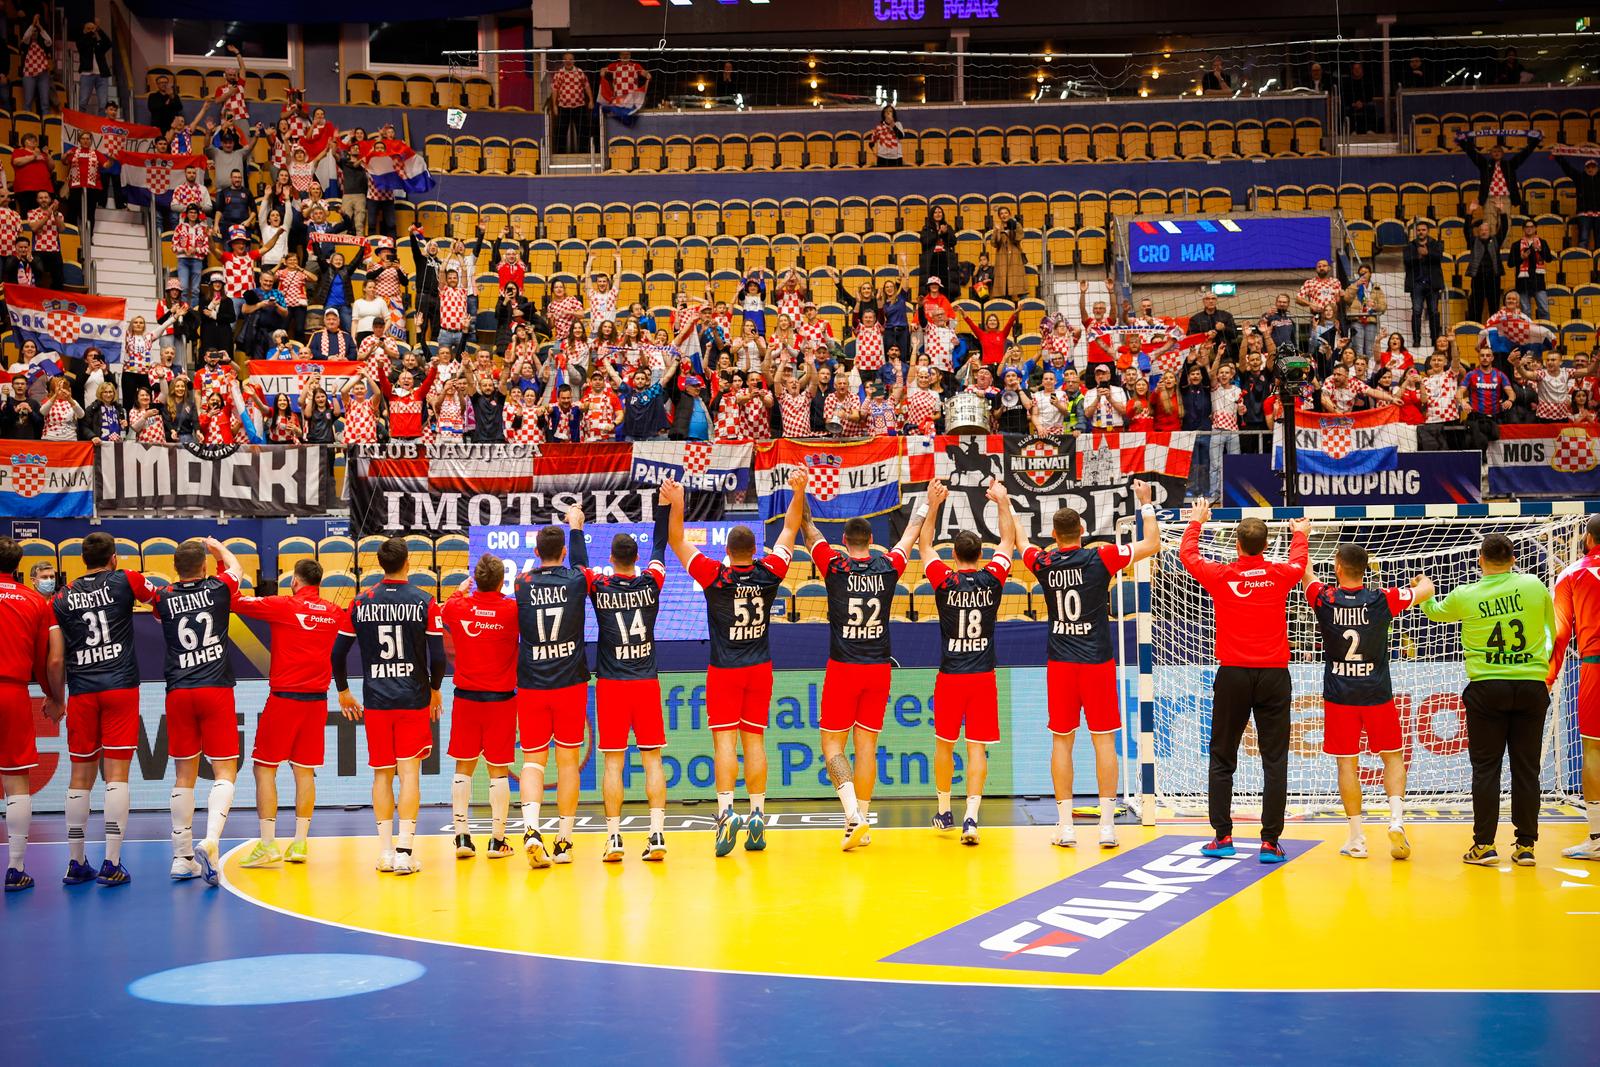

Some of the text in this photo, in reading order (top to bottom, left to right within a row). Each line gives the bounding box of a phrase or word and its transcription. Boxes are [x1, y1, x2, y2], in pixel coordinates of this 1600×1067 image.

[874, 0, 1000, 20] CRO MAR
[1139, 243, 1215, 262] CRO MAR
[81, 322, 122, 337] OVO
[260, 376, 293, 393] VIT
[1355, 429, 1375, 449] IN
[358, 443, 418, 459] KLUB
[1011, 454, 1070, 470] MI HRVATI
[1503, 443, 1545, 462] MOS
[49, 473, 88, 488] ANJA
[101, 440, 320, 506] IMOCKI
[848, 464, 887, 489] VLJE
[1293, 470, 1421, 496] ONKOPING
[383, 488, 657, 530] IMOTSKI
[487, 531, 519, 549] CRO
[847, 571, 885, 596] ŠUŠNJA
[1048, 568, 1083, 590] GOJUN
[67, 581, 114, 611] ŠEBETIĆ
[167, 585, 214, 619] JELINIĆ
[530, 584, 568, 606] ŠARAC
[596, 586, 656, 611] KRALJEVIĆ
[947, 586, 994, 608] KARAČIĆ
[1055, 589, 1081, 622] 10
[1478, 589, 1523, 619] SLAVIĆ
[356, 601, 424, 622] MARTINOVIĆ
[733, 596, 765, 627] 53
[847, 597, 882, 628] 52
[1333, 602, 1369, 626] MIHIĆ
[81, 610, 112, 646] 31
[178, 611, 221, 651] 62
[536, 606, 565, 643] 17
[615, 608, 648, 645] 14
[744, 623, 766, 639] HEP
[857, 625, 884, 639] HEP
[958, 609, 982, 639] 18
[1065, 622, 1092, 635] HEP
[378, 624, 405, 660] 51
[964, 637, 988, 652] HEP
[1342, 629, 1363, 662] 2
[1486, 618, 1526, 654] 43
[93, 643, 123, 664] HEP
[195, 645, 224, 666] HEP
[549, 641, 576, 659] HEP
[631, 642, 652, 660] HEP
[1501, 652, 1534, 665] HEP
[387, 662, 414, 677] HEP
[1346, 662, 1375, 677] HEP
